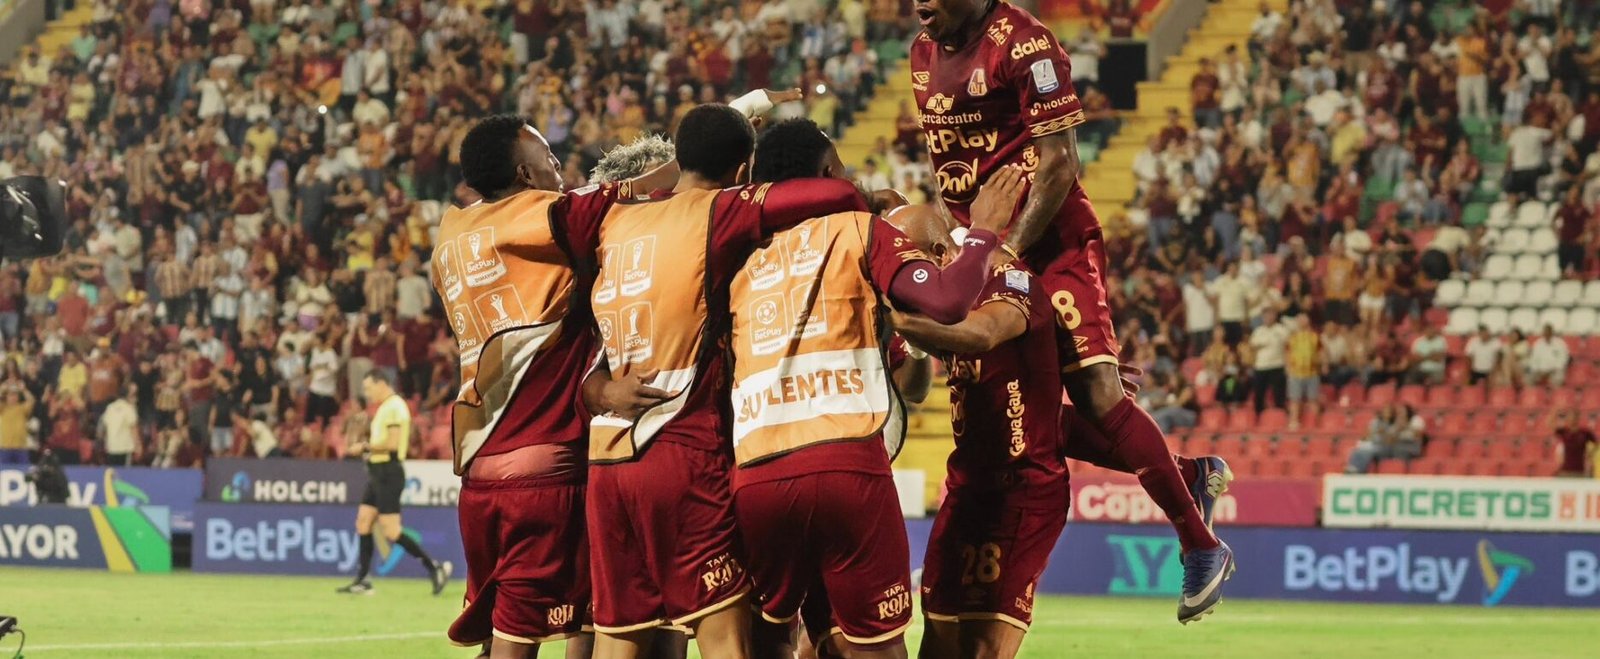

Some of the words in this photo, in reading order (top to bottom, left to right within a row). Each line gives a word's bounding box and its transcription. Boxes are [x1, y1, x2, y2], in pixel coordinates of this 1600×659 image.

[1011, 34, 1051, 60] dale!
[1043, 94, 1077, 111] HOLCIM
[925, 127, 998, 154] tPlay
[1051, 290, 1081, 330] 8
[737, 368, 864, 423] SULENTES
[1007, 379, 1025, 456] GanaGana
[254, 480, 347, 503] HOLCIM
[1332, 488, 1552, 518] CONCRETOS
[206, 516, 360, 571] BetPlay
[706, 552, 729, 568] TAP
[960, 543, 1002, 585] 28
[1284, 542, 1469, 602] BetPlay
[884, 585, 905, 598] TAPA
[548, 605, 574, 625] ROJA
[878, 592, 909, 620] ROJA
